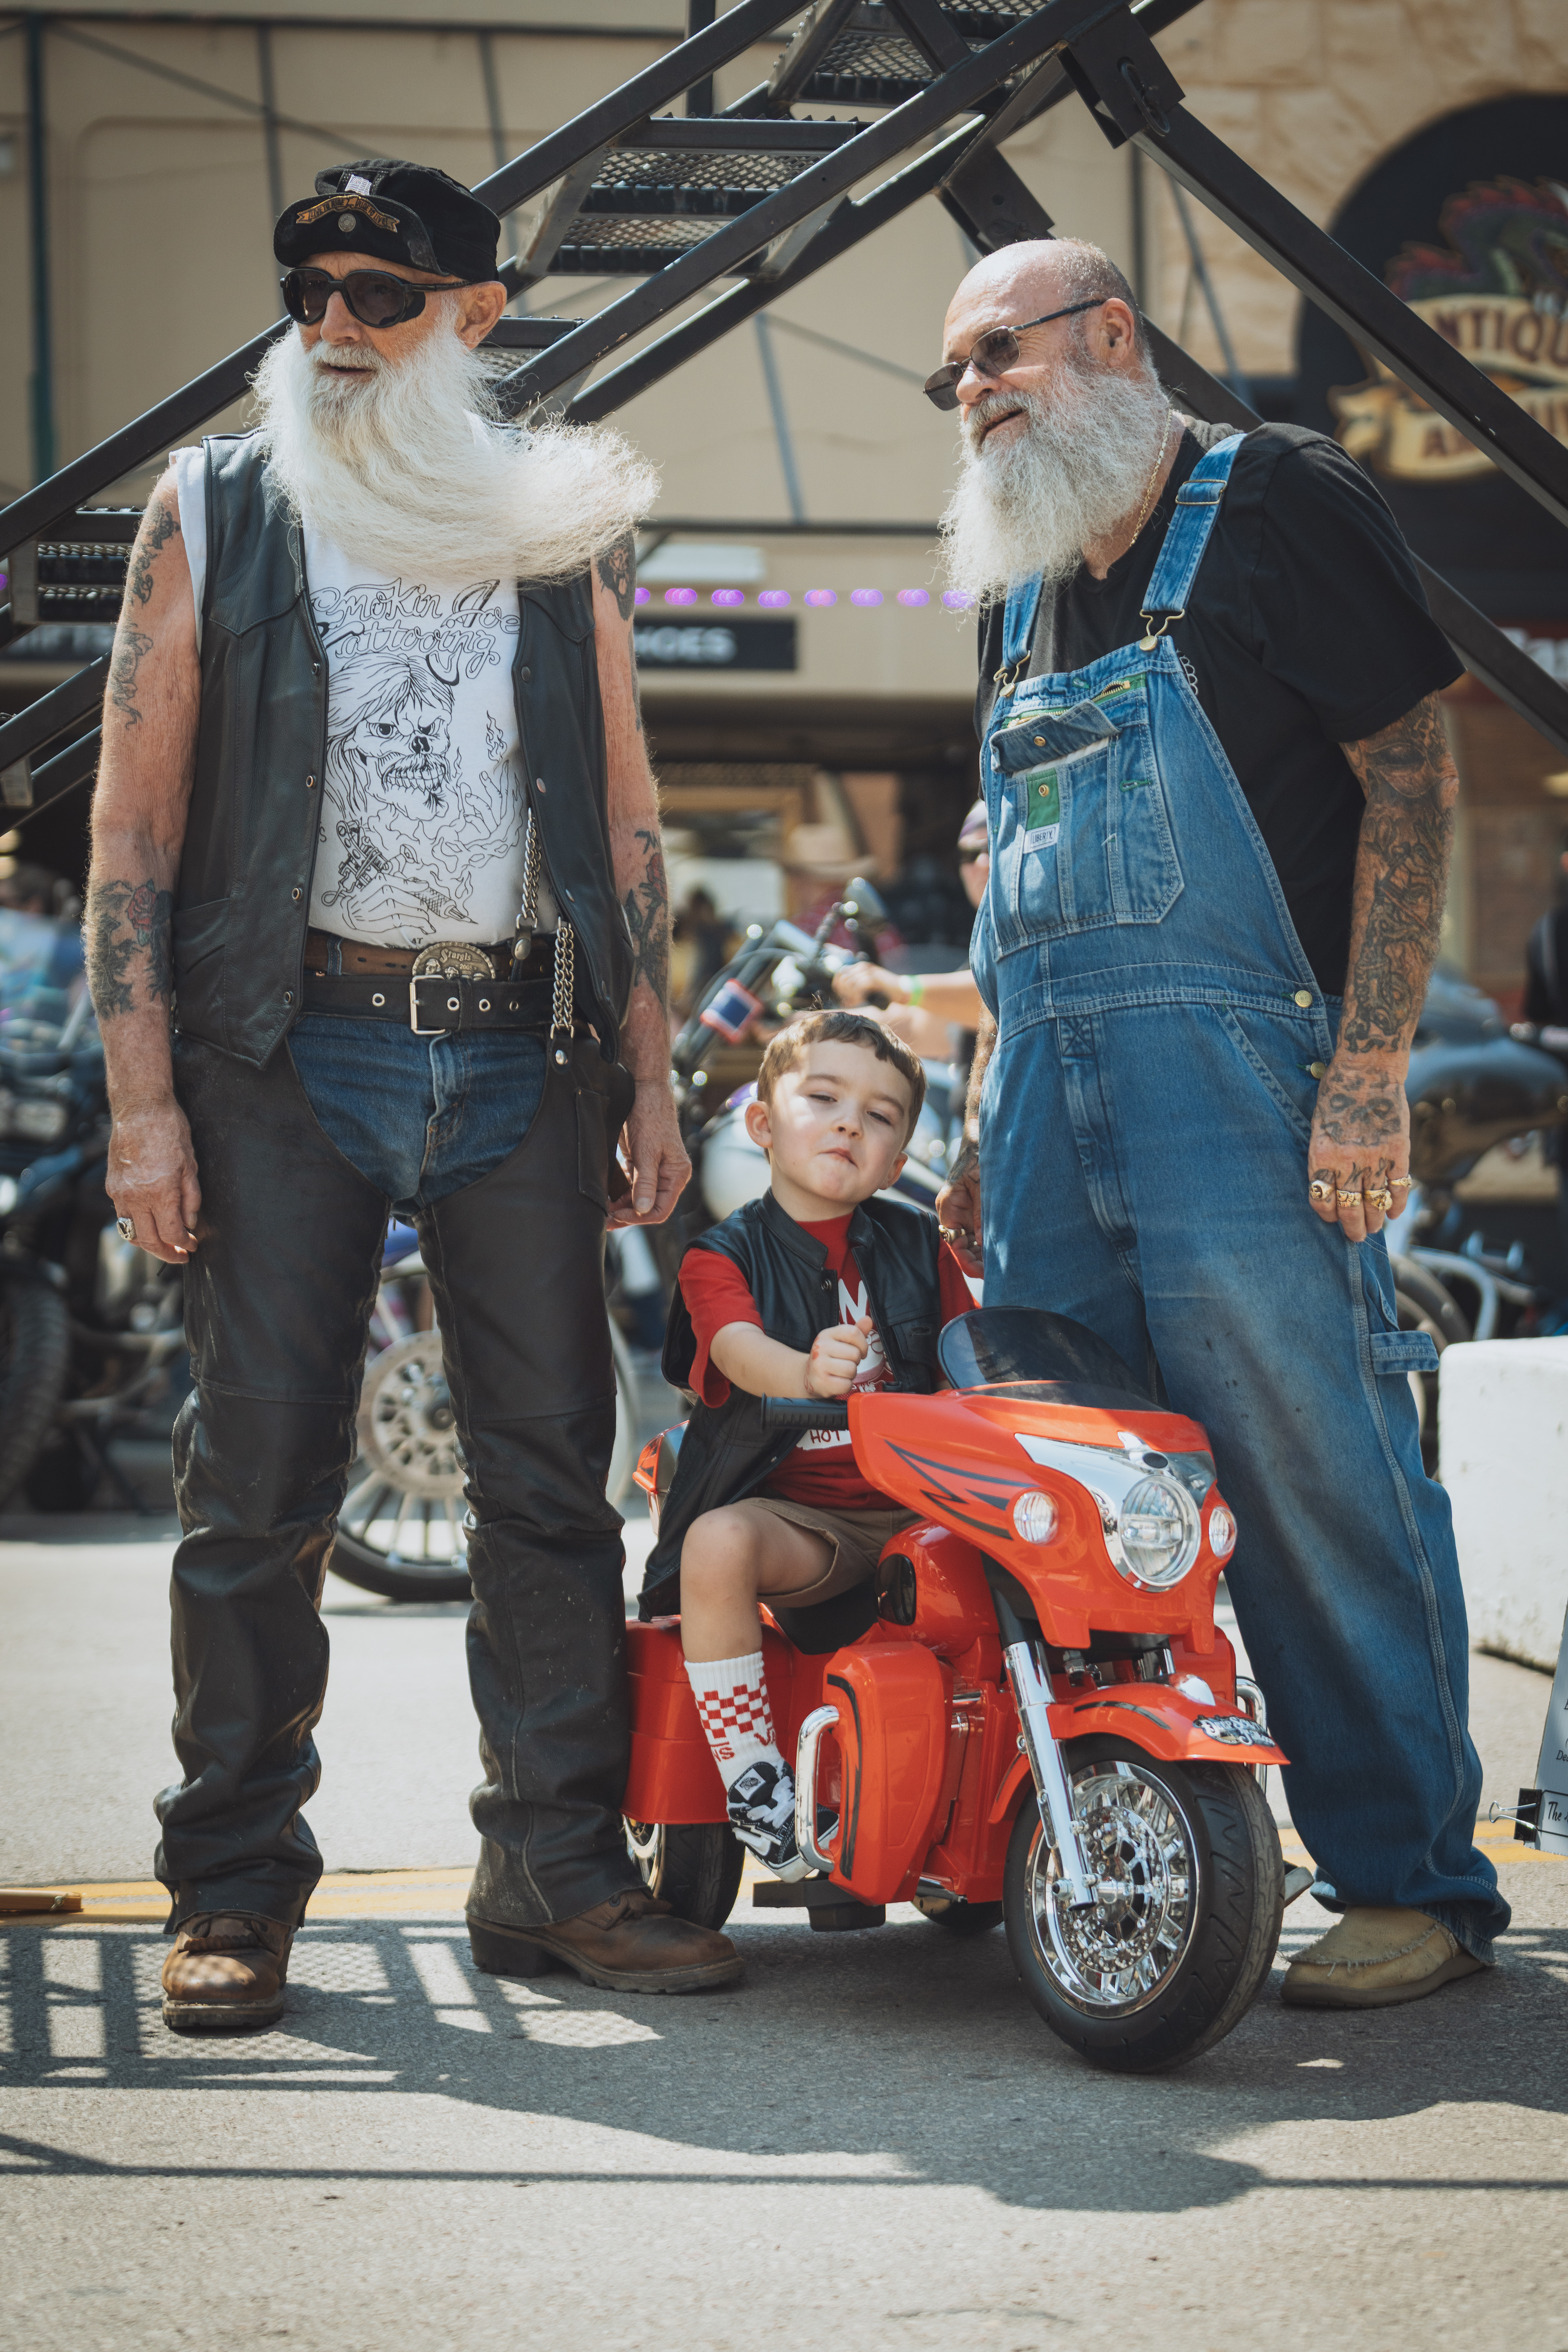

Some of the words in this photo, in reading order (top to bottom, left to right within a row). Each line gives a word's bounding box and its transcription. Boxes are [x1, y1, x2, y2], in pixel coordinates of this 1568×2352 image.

[309, 207, 324, 219] LIVE
[332, 198, 345, 207] RIDE
[357, 200, 370, 211] RIDE
[368, 207, 375, 216] TO
[374, 212, 387, 225] LIVE
[1432, 304, 1568, 371] NTIQU
[316, 620, 500, 679] Tattooing
[1032, 830, 1052, 844] LIBERTY
[440, 948, 471, 963] Sturgis
[1548, 1801, 1562, 1821] The
